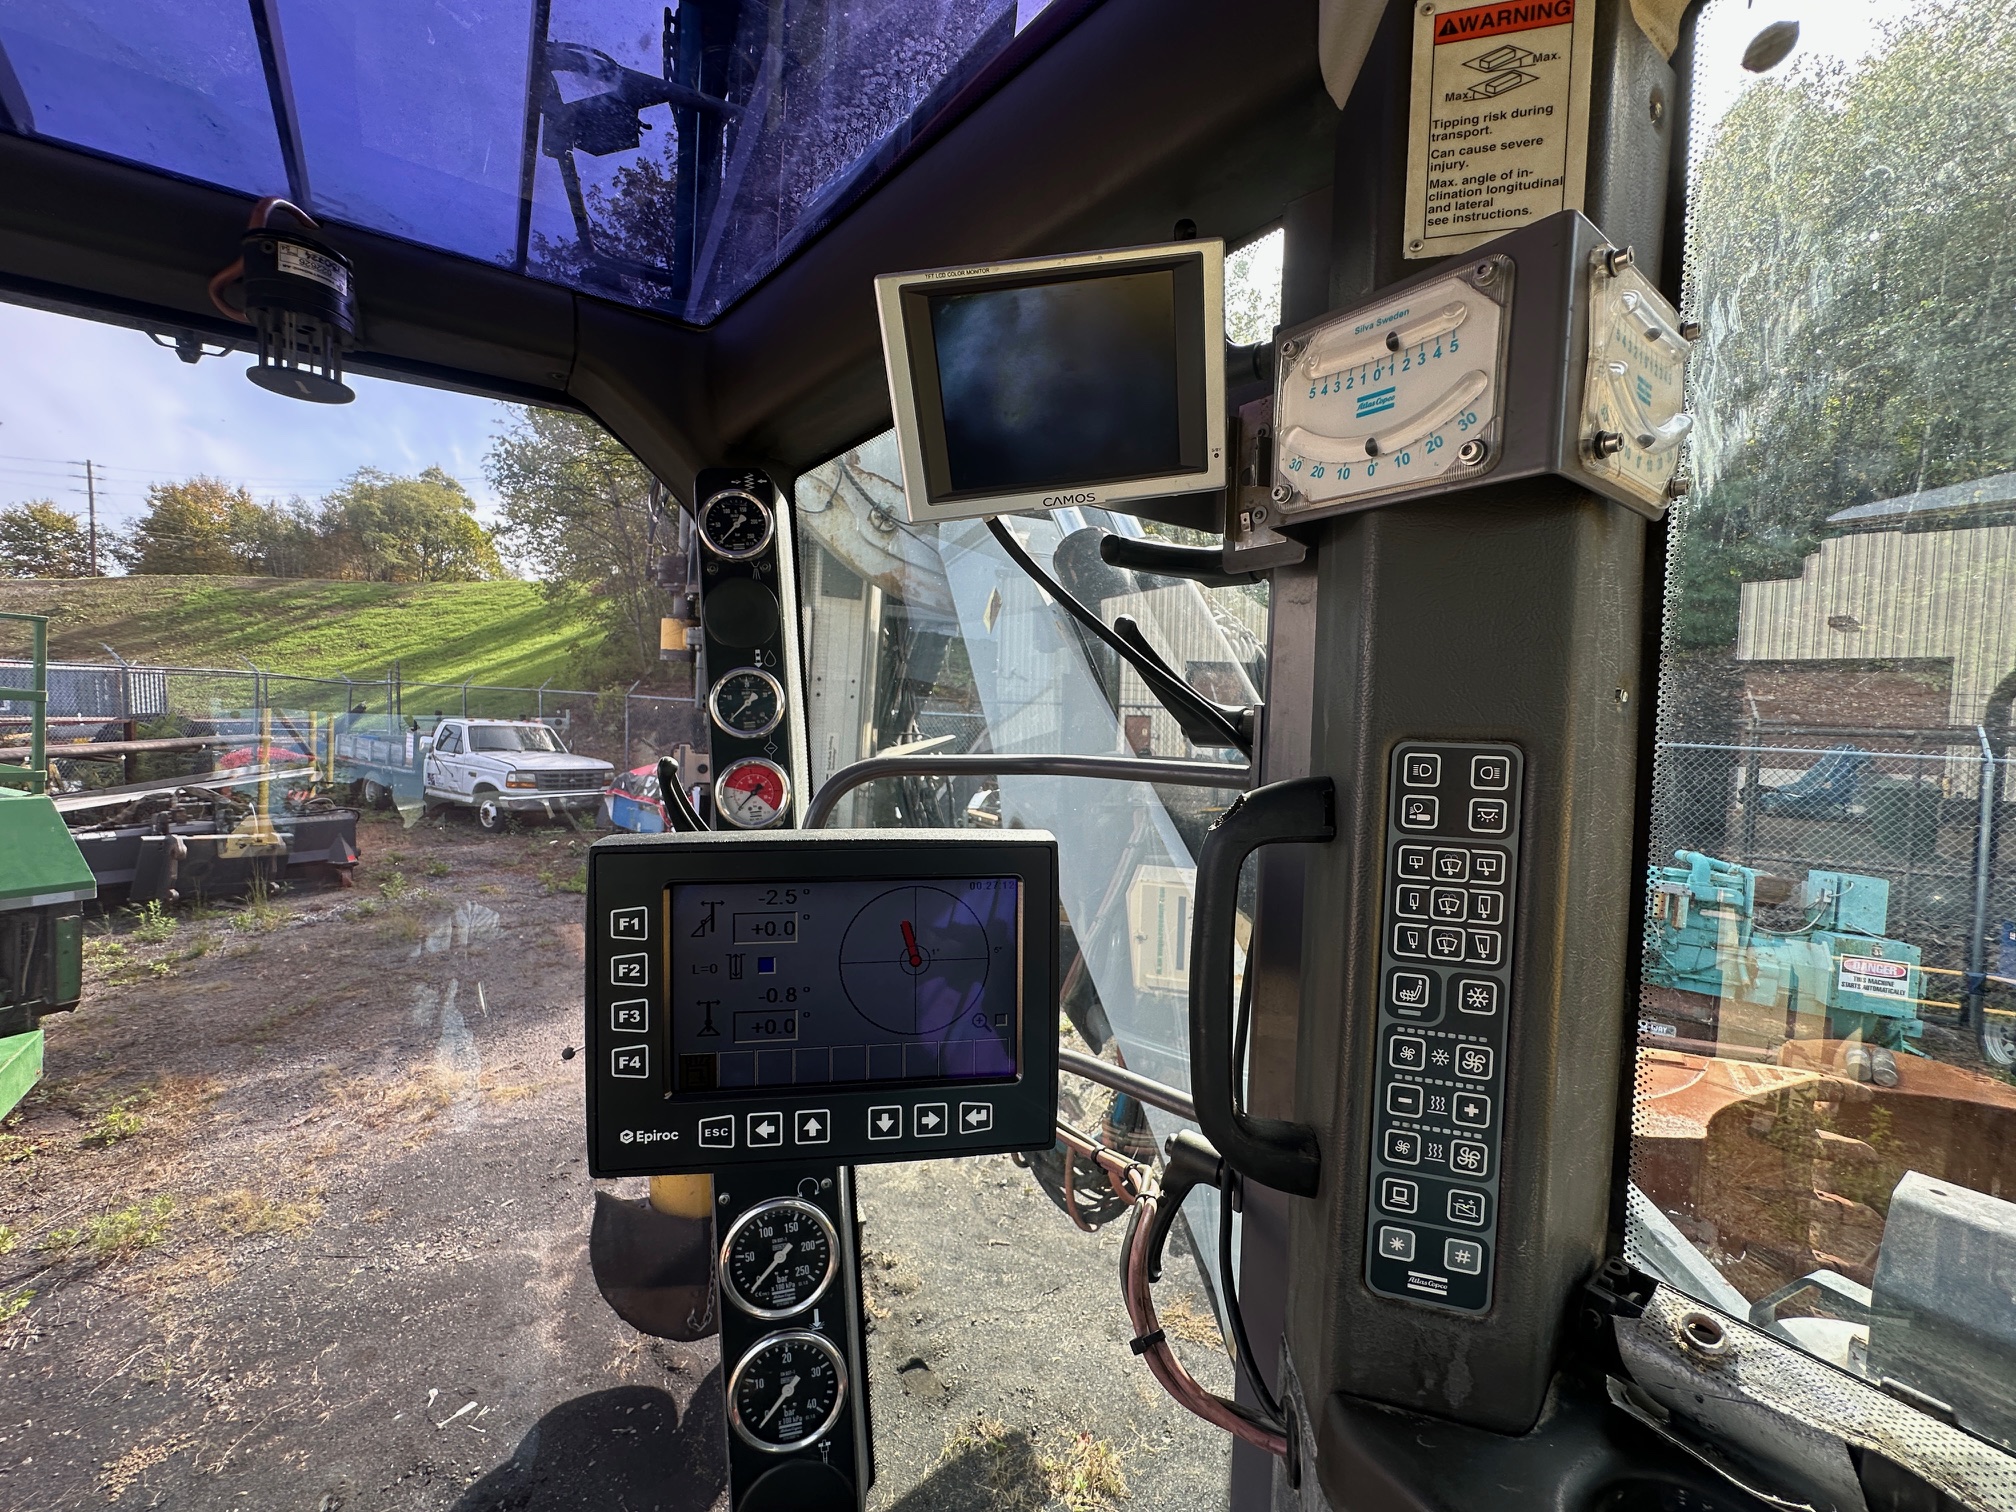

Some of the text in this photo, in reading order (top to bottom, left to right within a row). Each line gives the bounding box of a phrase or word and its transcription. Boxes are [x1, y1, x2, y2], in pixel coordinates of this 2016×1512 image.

[1459, 0, 1572, 33] WARNING
[1533, 52, 1561, 64] Max.
[1445, 92, 1472, 102] Max.
[1432, 105, 1554, 129] Tipping risk during
[1432, 125, 1492, 142] transport.
[1431, 137, 1544, 160] Can cause severe
[1430, 160, 1469, 173] injury.
[1430, 168, 1534, 190] Max. angle of in-
[1428, 176, 1564, 202] clination longitudinal
[1428, 198, 1494, 214] and lateral
[1428, 206, 1532, 226] see instructions.
[1354, 309, 1410, 335] Silva Sweden
[1309, 387, 1316, 399] 5
[1321, 384, 1328, 396] 4
[1334, 381, 1340, 393] 3
[1346, 378, 1354, 390] 2
[1360, 373, 1366, 385] 1
[1388, 364, 1394, 376] 1
[1402, 358, 1410, 372] 2
[1418, 353, 1426, 366] 3
[1433, 346, 1442, 358] 4
[1450, 339, 1459, 352] 5
[1357, 395, 1396, 410] Atlas Copco
[1289, 458, 1302, 472] 30
[1310, 465, 1324, 478] 20
[1337, 468, 1350, 480] 10
[1394, 452, 1410, 468] 10
[1425, 436, 1444, 454] 20
[1458, 412, 1477, 432] 30
[1042, 492, 1096, 508] CAMOS
[619, 918, 639, 930] F1
[752, 920, 796, 936] +0.0
[618, 964, 640, 977] F2
[692, 964, 718, 974] L=0
[1853, 962, 1897, 976] DANGER
[1841, 982, 1906, 996] STARTS AUTOMATICALLY
[1868, 978, 1894, 988] MACHINE
[618, 1010, 640, 1023] F3
[752, 1018, 796, 1034] +0.0
[618, 1056, 641, 1069] F4
[636, 1130, 679, 1144] Epiroc
[704, 1127, 728, 1138] ESC
[759, 1222, 798, 1238] 100 150
[744, 1251, 755, 1262] 50
[800, 1240, 816, 1252] 200
[776, 1275, 788, 1284] bar
[795, 1265, 810, 1277] 250
[1408, 1276, 1448, 1290] Atlas Copco
[782, 1354, 792, 1364] 20
[755, 1366, 821, 1390] 10 30
[784, 1409, 795, 1417] bar
[807, 1398, 816, 1410] 40
